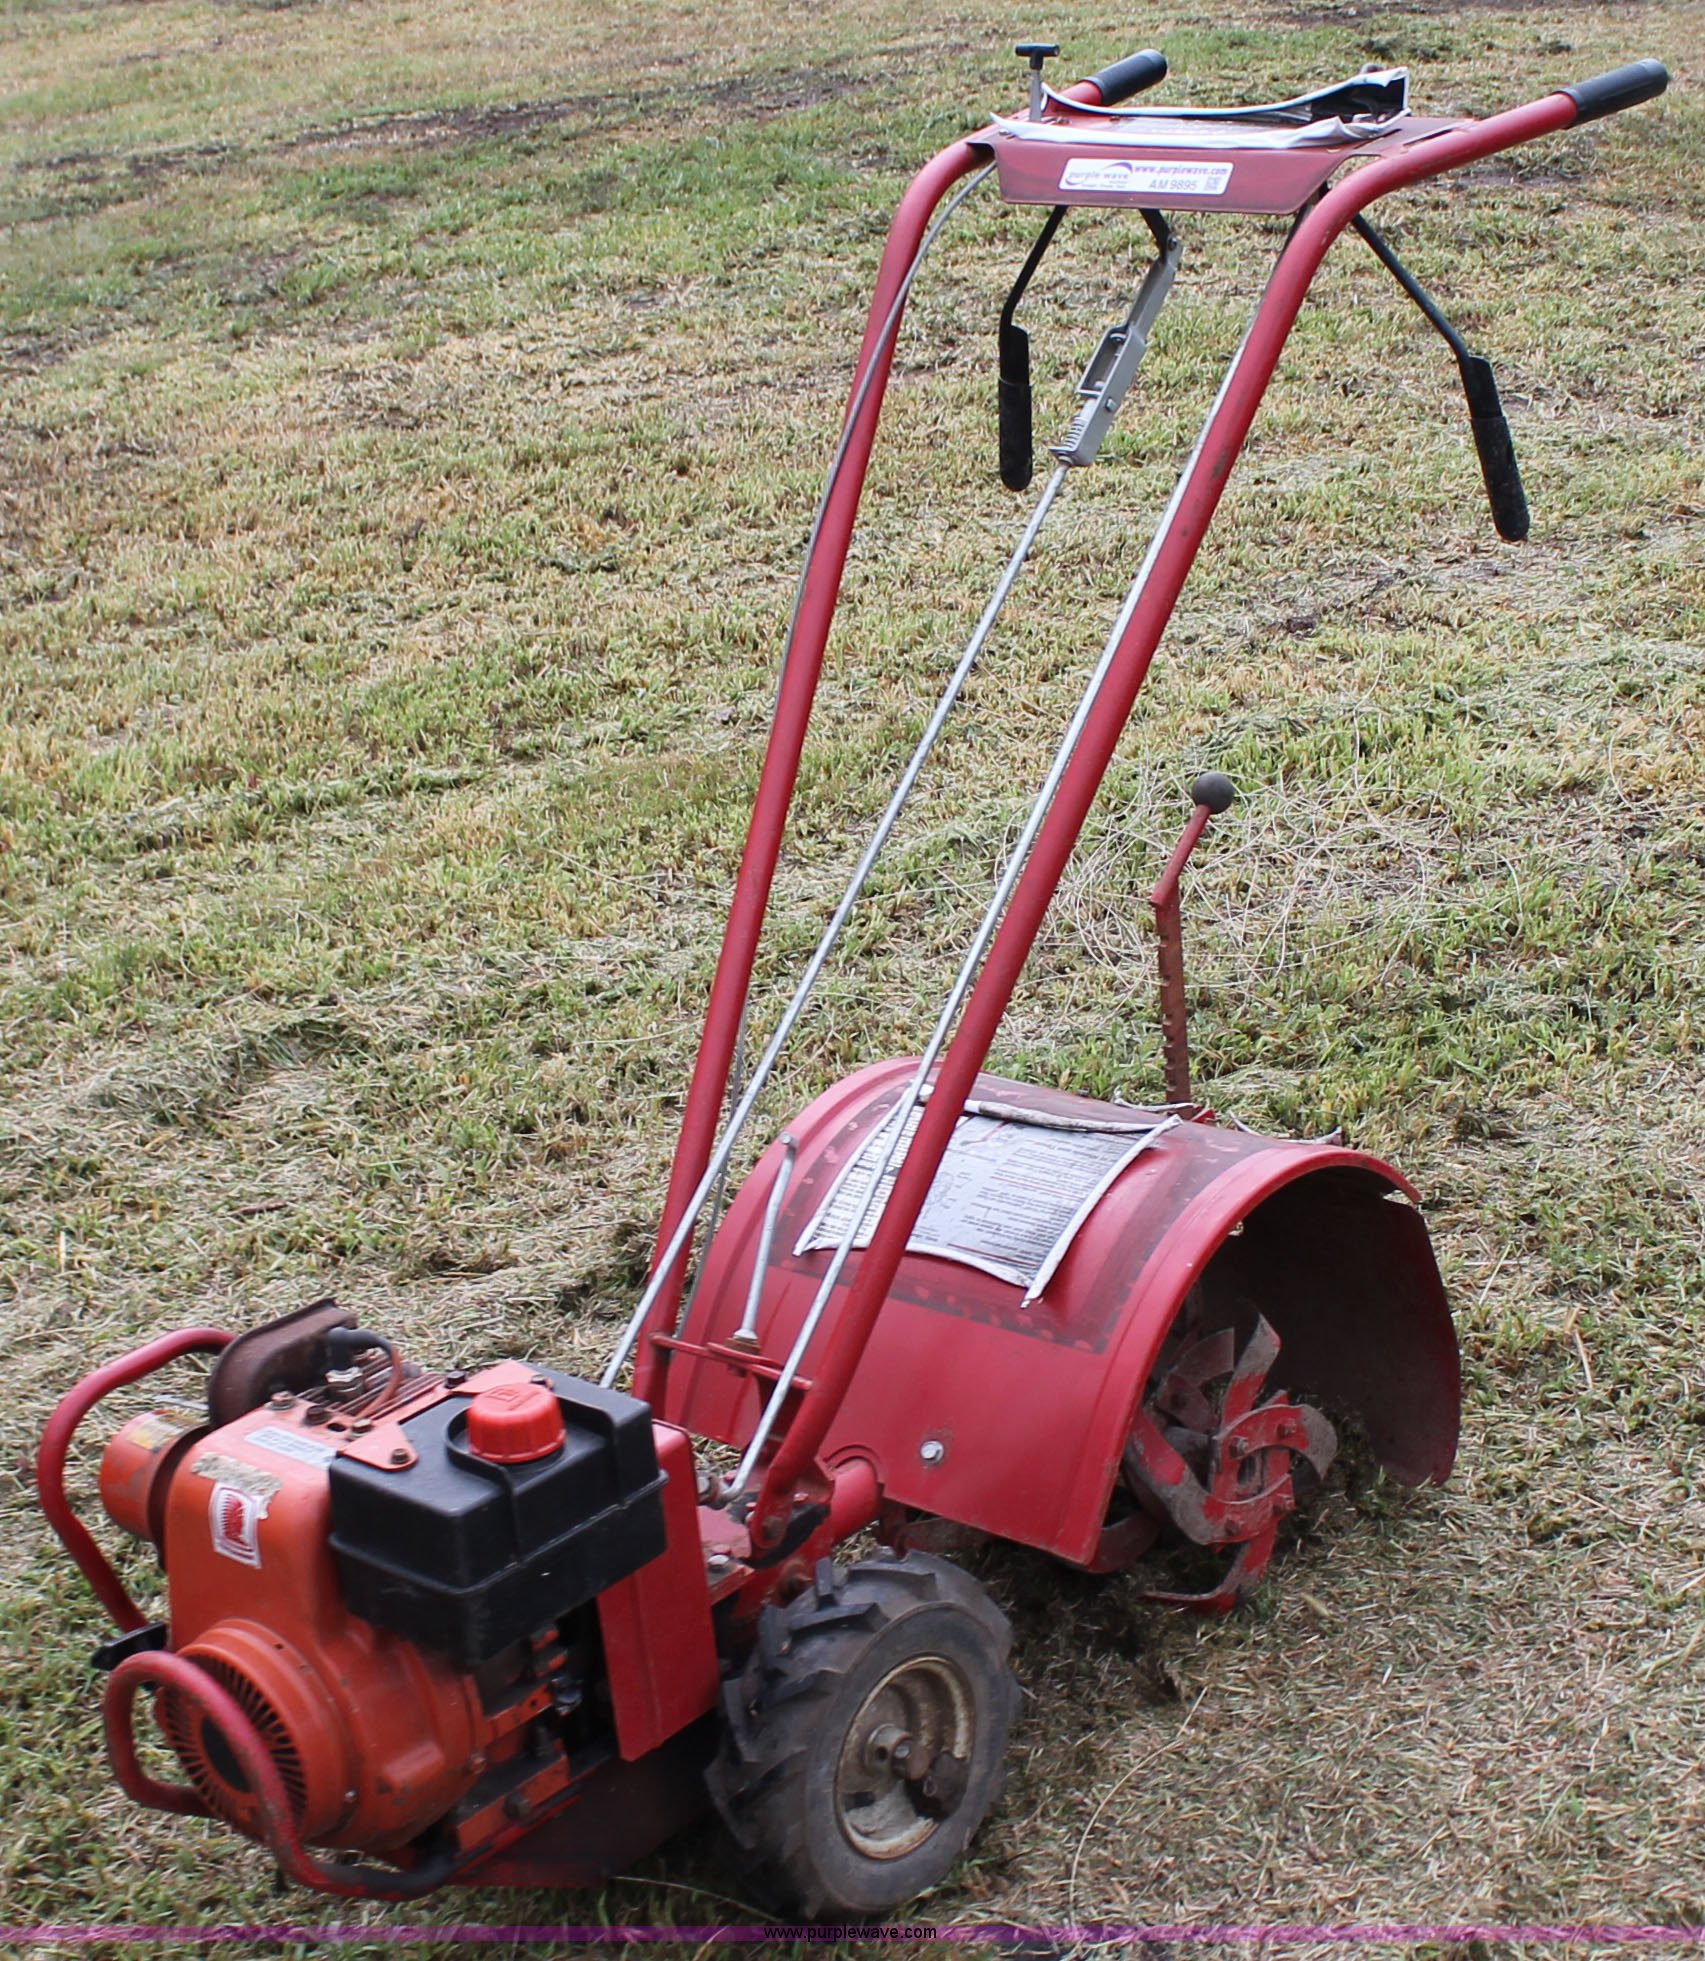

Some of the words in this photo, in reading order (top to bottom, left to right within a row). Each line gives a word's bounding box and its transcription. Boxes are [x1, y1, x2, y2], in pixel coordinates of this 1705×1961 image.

[1068, 171, 1100, 180] purple
[1134, 165, 1228, 176] www.purplewave.com
[1148, 179, 1168, 190] AM
[1169, 180, 1198, 191] 9895
